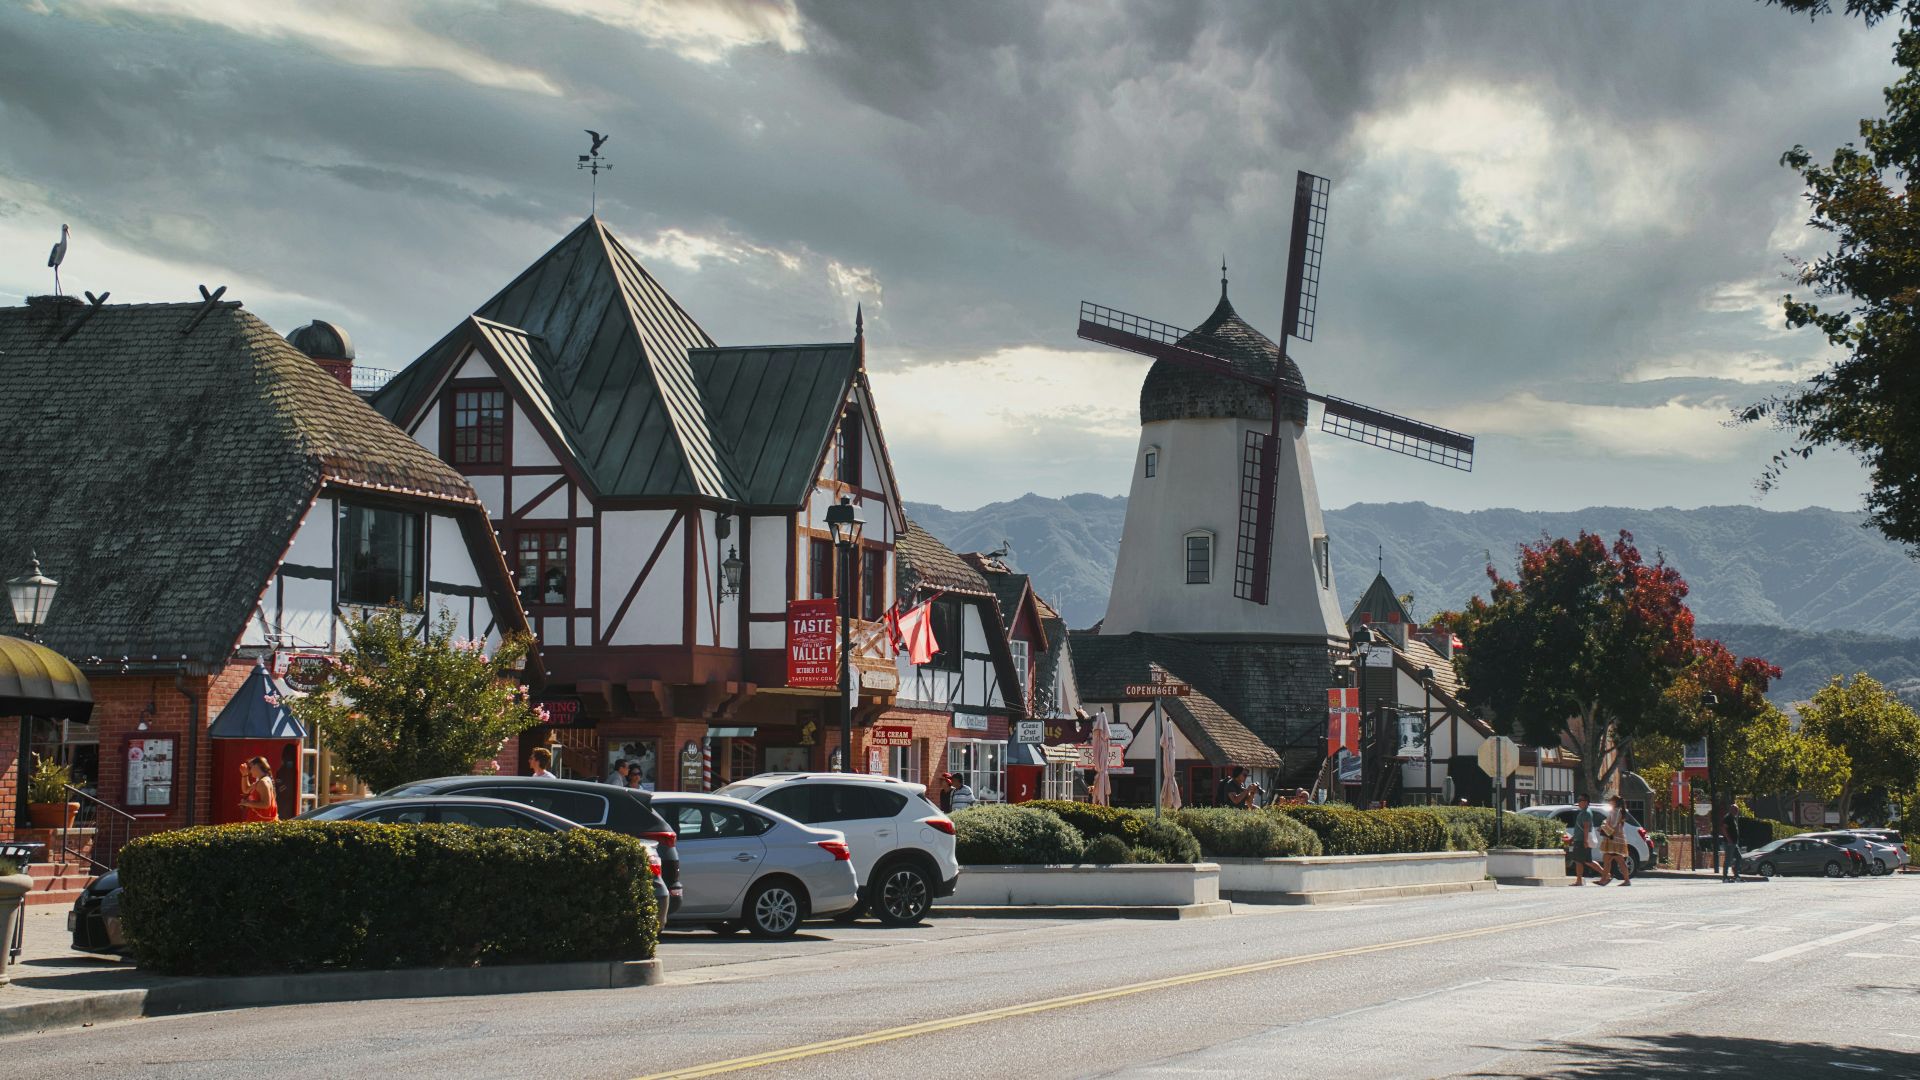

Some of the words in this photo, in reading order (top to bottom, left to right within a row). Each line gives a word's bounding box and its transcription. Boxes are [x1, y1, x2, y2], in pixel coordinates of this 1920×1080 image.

[793, 619, 832, 634] TASTE
[792, 646, 832, 660] VALLEY
[297, 658, 321, 666] VIKING
[1126, 685, 1178, 695] COPENHAGEN
